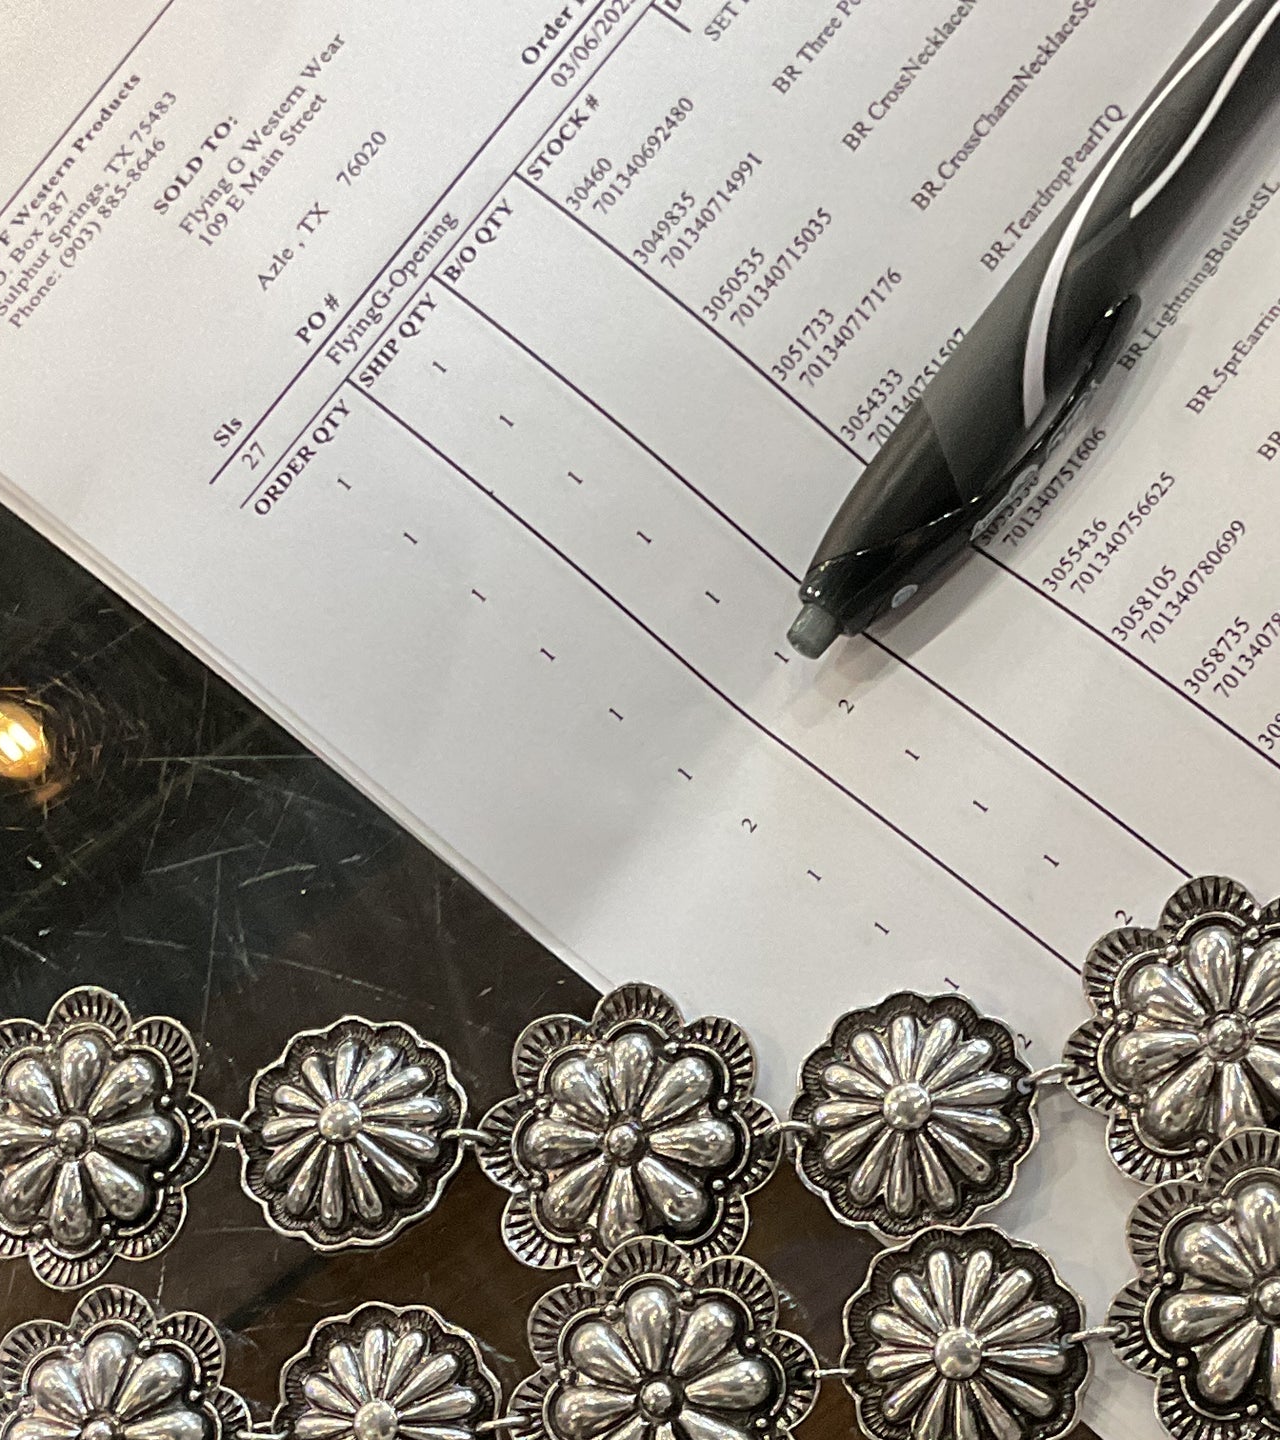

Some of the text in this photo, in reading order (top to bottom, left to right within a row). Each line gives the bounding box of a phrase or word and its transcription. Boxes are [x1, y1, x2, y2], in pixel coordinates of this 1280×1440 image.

[521, 5, 573, 64] Order
[550, 0, 636, 87] 03/06/202
[703, 1, 739, 42] SET
[771, 64, 803, 94] BR
[795, 16, 842, 63] Three
[9, 156, 76, 225] Western
[71, 74, 141, 153] Products
[47, 181, 110, 248] Springs,
[103, 143, 135, 174] TX
[129, 91, 177, 142] 75483
[153, 115, 238, 215] SOLD TO:
[178, 33, 345, 235] Flying G Western Wear
[198, 93, 327, 246] 109 E Main Street
[526, 93, 599, 181] STOCK #
[592, 96, 694, 214] 701340692480
[841, 120, 874, 152] BR
[257, 247, 294, 291] Azle
[296, 201, 330, 234] TX
[335, 130, 387, 186] 76020
[565, 157, 613, 211] 30460
[660, 151, 763, 268] 701340714991
[8, 227, 44, 264] Box
[39, 189, 69, 226] 287
[8, 136, 166, 329] Phone: (903) 885-8646
[442, 197, 514, 283] B/O QTY
[632, 190, 695, 265] 3049835
[324, 211, 459, 365] FlyingG-Opening
[702, 246, 765, 322] 3050535
[729, 206, 832, 326] 701340715035
[294, 292, 340, 344] PO #
[358, 291, 437, 388] SHIP QTY
[771, 307, 834, 382] 3051733
[798, 266, 902, 387] 701340717176
[432, 360, 447, 373] 1
[213, 417, 242, 448] Sls
[499, 414, 514, 427] 1
[840, 368, 903, 441] 3054333
[241, 440, 265, 471] 27
[254, 398, 350, 515] ORDER QTY
[336, 477, 352, 491] 1
[567, 470, 584, 485] 1
[1001, 425, 1105, 546] 701340751606
[403, 531, 418, 545] 1
[636, 530, 652, 544] 1
[1042, 517, 1107, 592] 3055436
[1069, 470, 1175, 594] 701340756625
[471, 588, 487, 602] 1
[704, 590, 721, 604] 1
[1111, 564, 1177, 641] 3058105
[1140, 519, 1246, 644] 701340780699
[539, 647, 556, 661] 1
[773, 650, 790, 664] 1
[1183, 615, 1250, 694] 3058735
[608, 707, 624, 721] 1
[837, 698, 855, 714] 2
[677, 767, 693, 780] 1
[904, 748, 920, 761] 1
[741, 817, 758, 833] 2
[972, 799, 989, 813] 1
[806, 868, 822, 881] 1
[1043, 853, 1060, 868] 1
[873, 921, 890, 935] 1
[944, 977, 960, 990] 1
